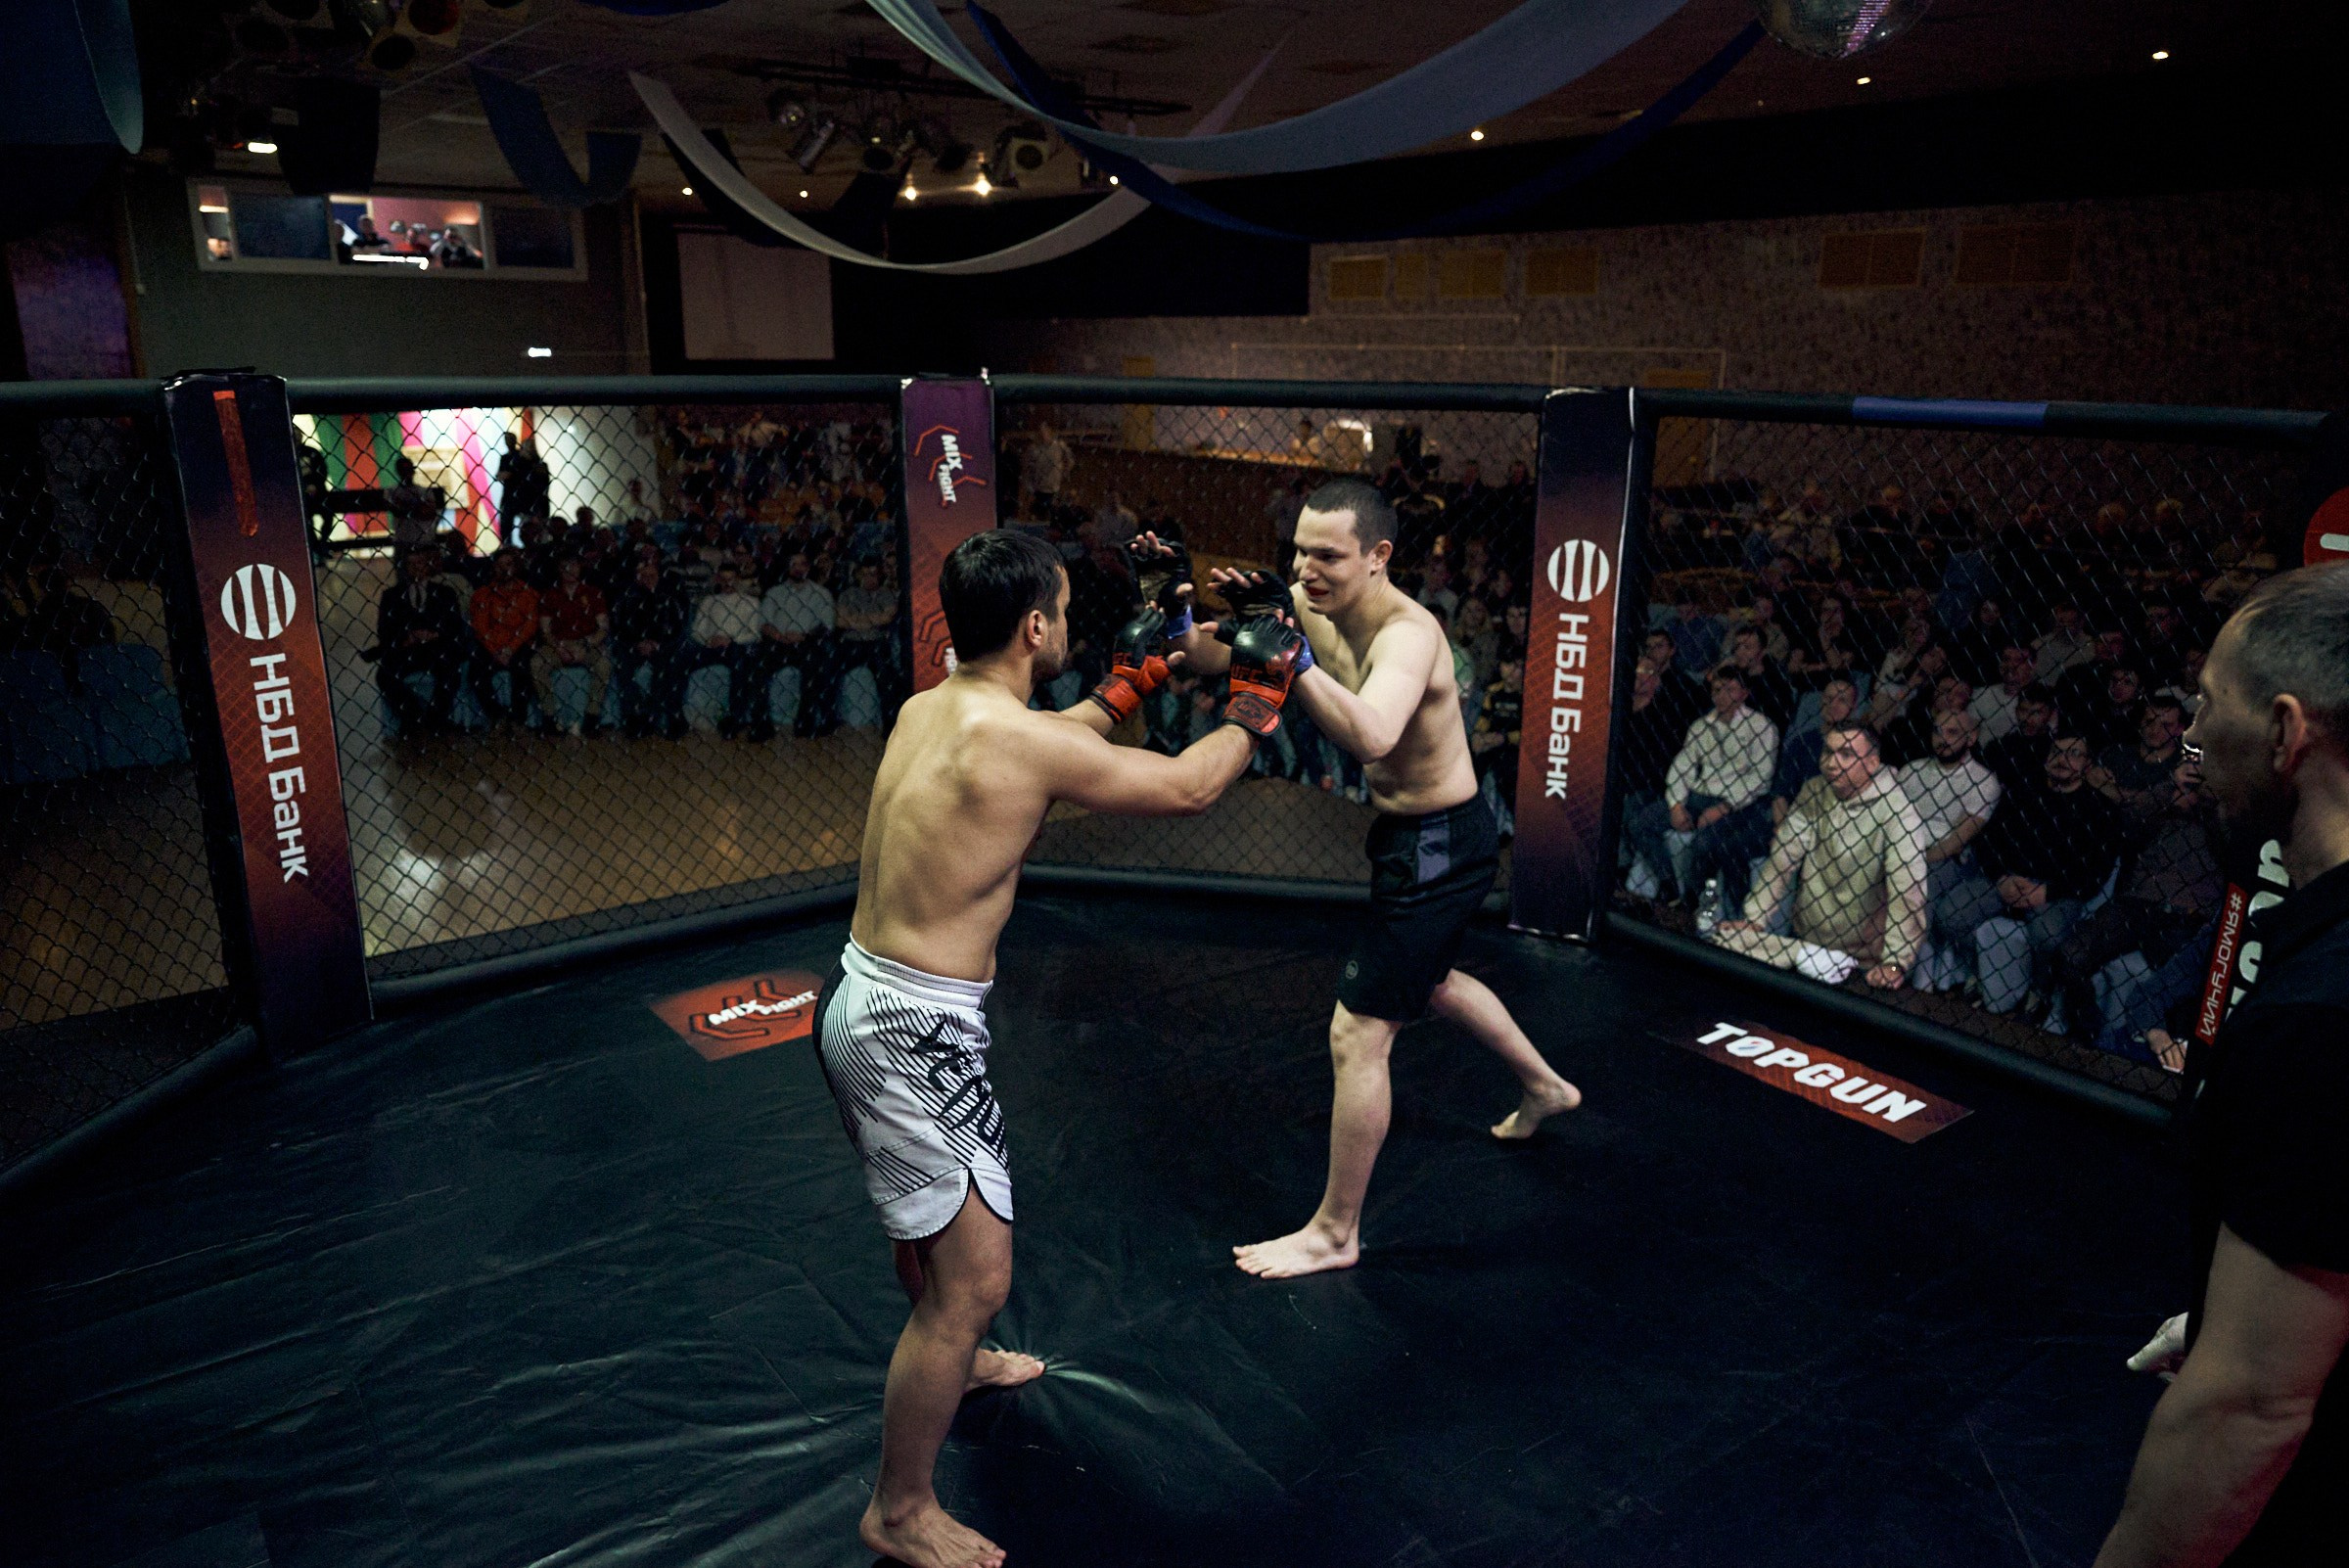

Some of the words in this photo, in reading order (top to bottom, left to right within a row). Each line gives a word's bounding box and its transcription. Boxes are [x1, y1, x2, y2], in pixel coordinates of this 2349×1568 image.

[938, 462, 957, 502] FIGHT
[941, 434, 963, 470] MIX
[1552, 612, 1589, 701] НБД
[250, 652, 300, 763] НБД
[1544, 706, 1582, 801] Банк
[268, 765, 310, 884] Банк
[760, 991, 817, 1015] FIGHT
[2200, 892, 2242, 1038] #ЯМОГУЧИЙ
[709, 999, 763, 1025] MIX
[1695, 1021, 1928, 1124] TOPGUN
